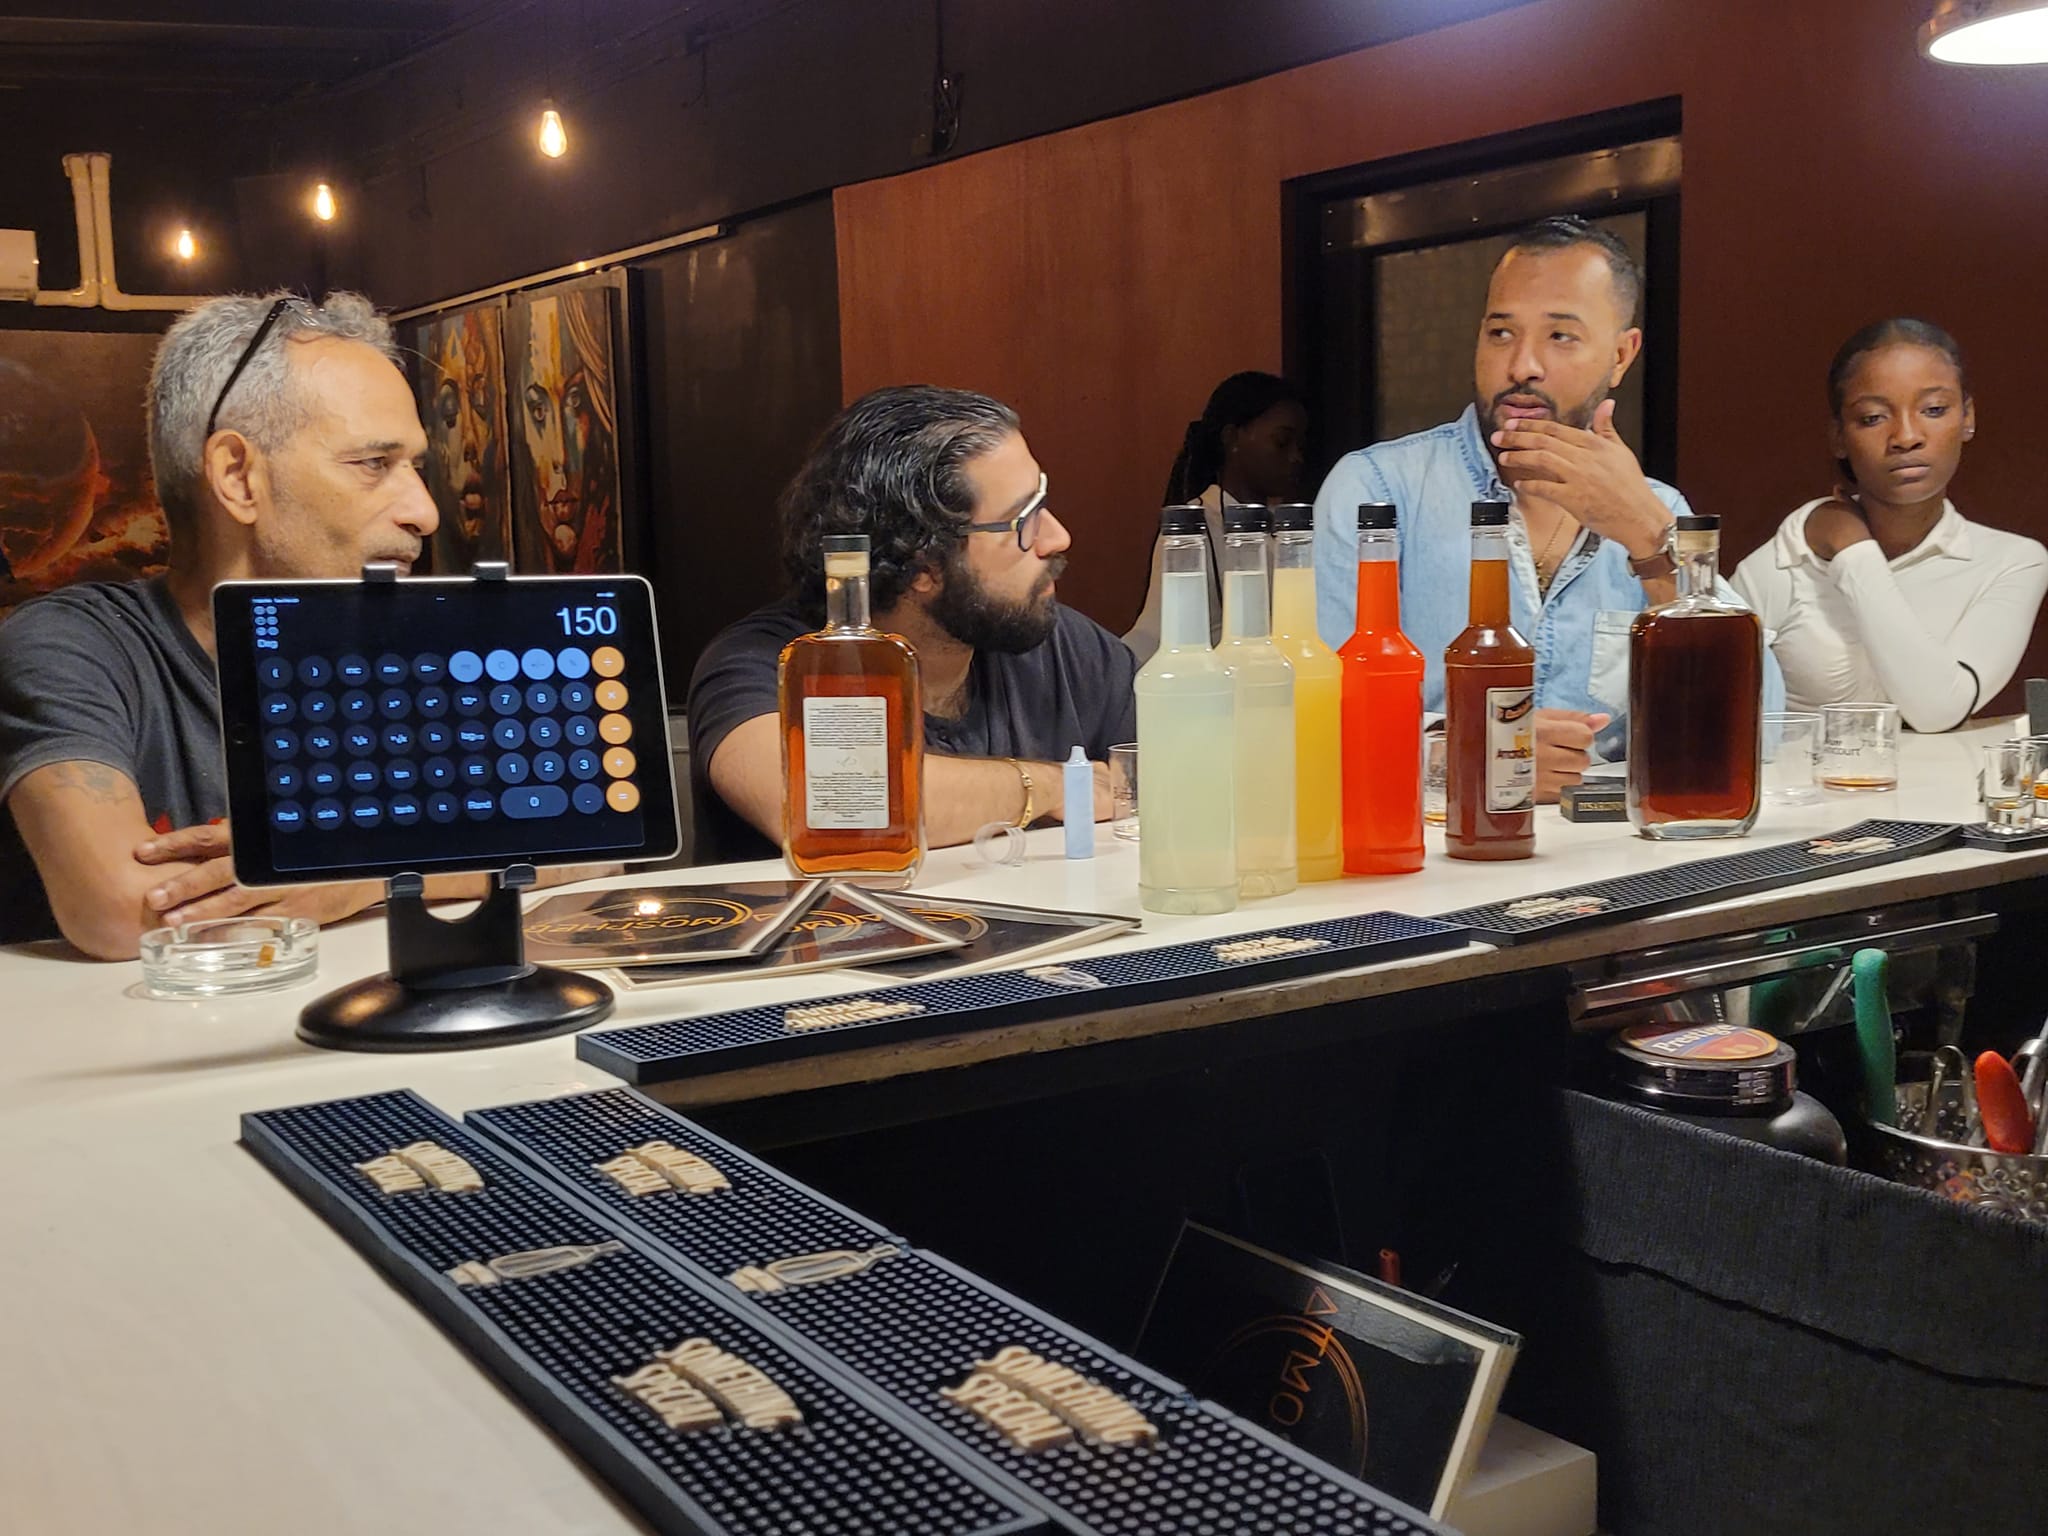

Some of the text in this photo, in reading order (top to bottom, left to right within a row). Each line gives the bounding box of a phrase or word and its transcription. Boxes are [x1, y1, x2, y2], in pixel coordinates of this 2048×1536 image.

[557, 606, 617, 636] 150
[501, 694, 510, 704] 7
[537, 693, 546, 703] 8
[572, 692, 581, 701] 9
[505, 729, 513, 739] 4
[541, 727, 550, 737] 5
[576, 726, 585, 735] 6
[509, 763, 517, 773] 1
[544, 761, 554, 771] 2
[579, 760, 589, 769] 3
[529, 797, 539, 807] 0
[610, 1362, 724, 1430] SPECIAL
[654, 1336, 804, 1429] SOMETHING
[974, 1345, 1160, 1444] SOMETHING
[939, 1372, 1074, 1449] SPECIAL
